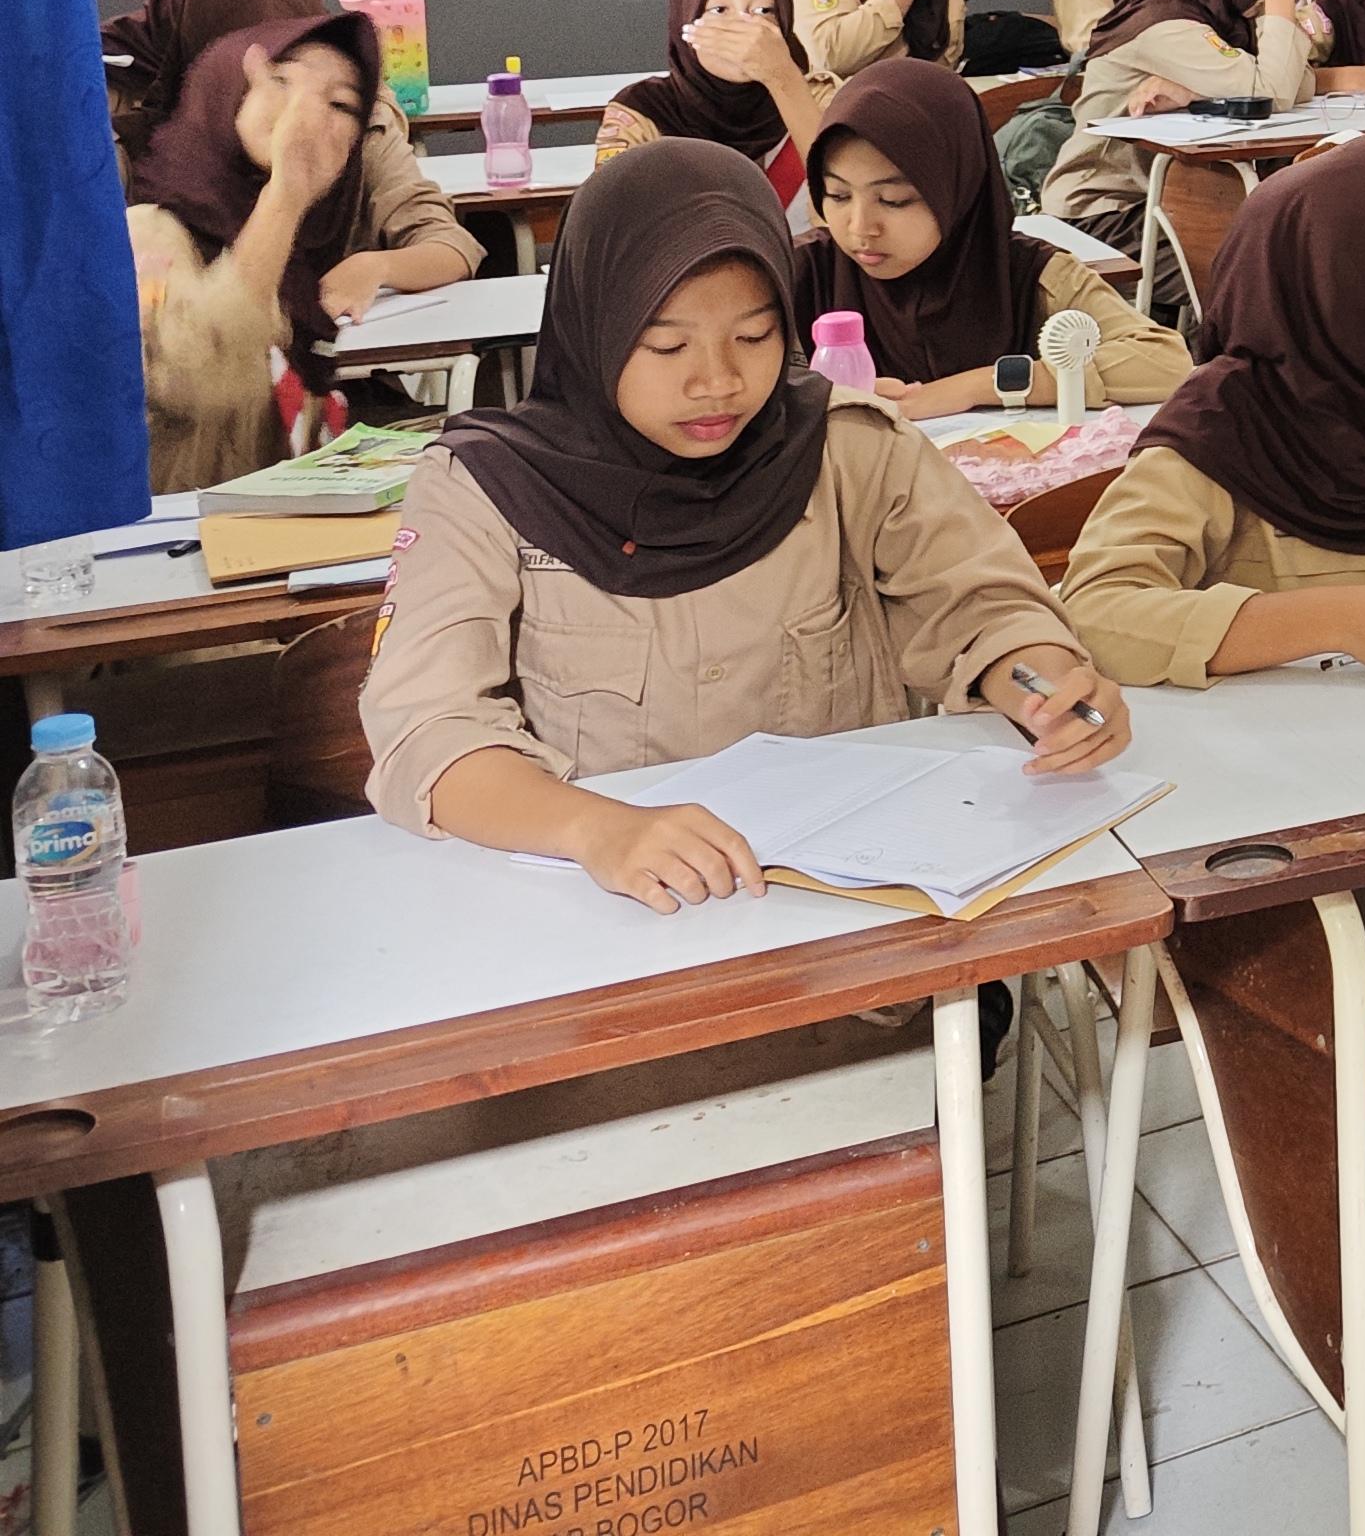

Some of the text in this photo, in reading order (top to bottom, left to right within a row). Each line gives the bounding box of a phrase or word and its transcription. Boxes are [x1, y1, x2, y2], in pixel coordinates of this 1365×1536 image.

[30, 831, 98, 857] prima
[467, 1436, 759, 1536] DINAS PENDIDIKAN
[517, 1408, 709, 1487] APBD-P 2017
